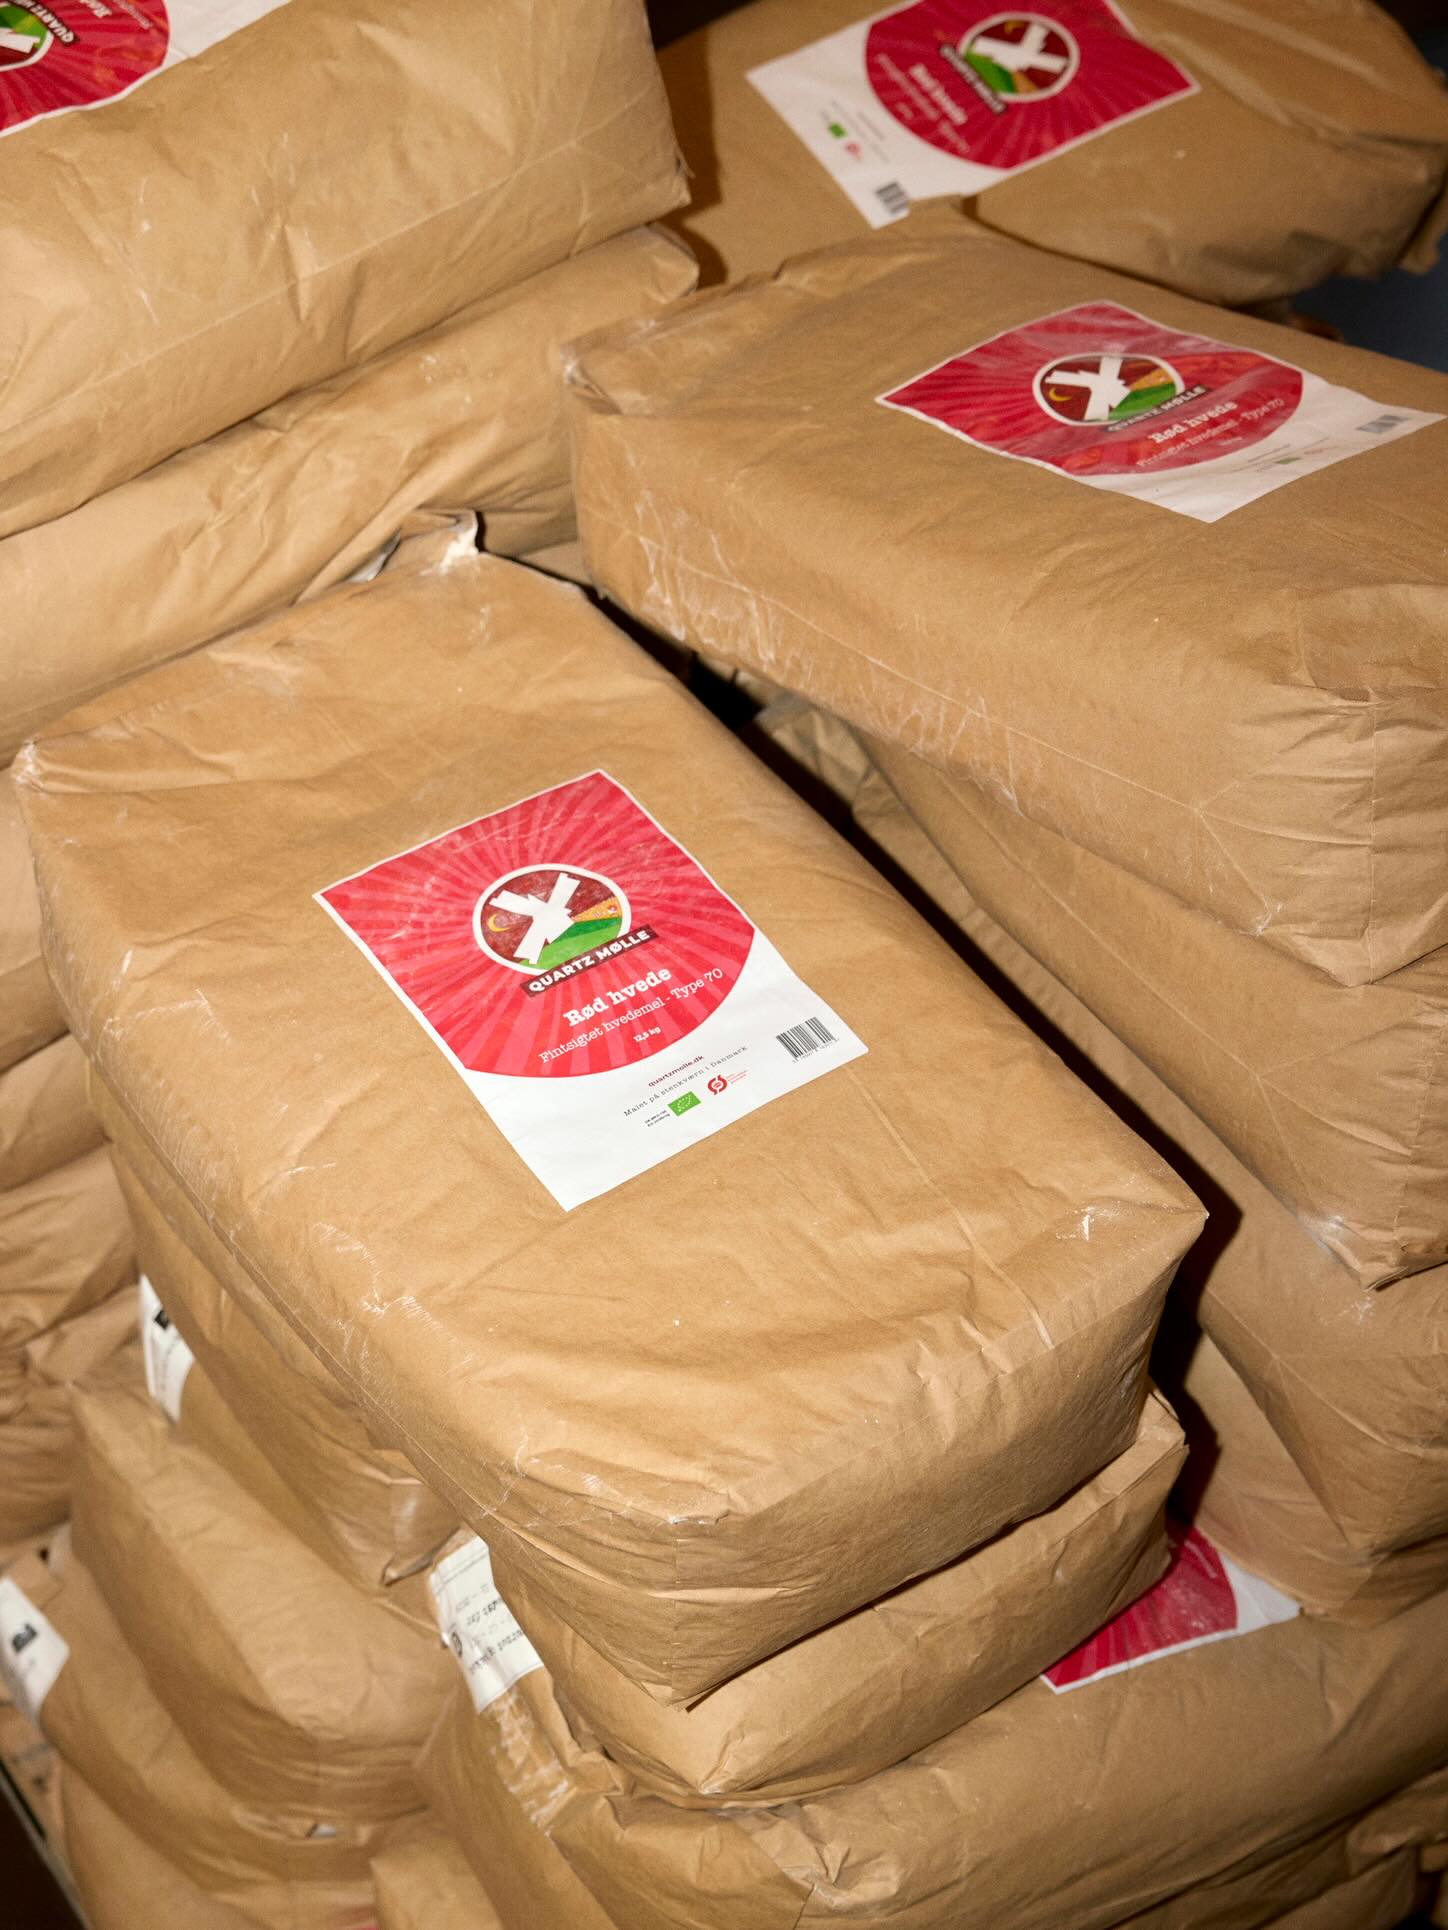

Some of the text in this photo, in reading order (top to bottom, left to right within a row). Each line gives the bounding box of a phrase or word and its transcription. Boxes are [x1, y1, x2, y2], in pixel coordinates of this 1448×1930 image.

[1149, 401, 1239, 444] Rød hvede
[528, 929, 650, 993] QUARTZ MØLLE
[538, 1027, 604, 1064] Fintsigtet
[602, 996, 664, 1033] hvedemel
[670, 977, 705, 1001] Type
[703, 967, 724, 984] 70
[563, 967, 673, 1027] Rød hvede
[633, 1026, 662, 1043] 12,5 kg
[623, 1099, 648, 1118] Malet
[648, 1092, 661, 1104] på
[660, 1069, 705, 1097] stenkværn
[711, 1045, 748, 1068] Danmark
